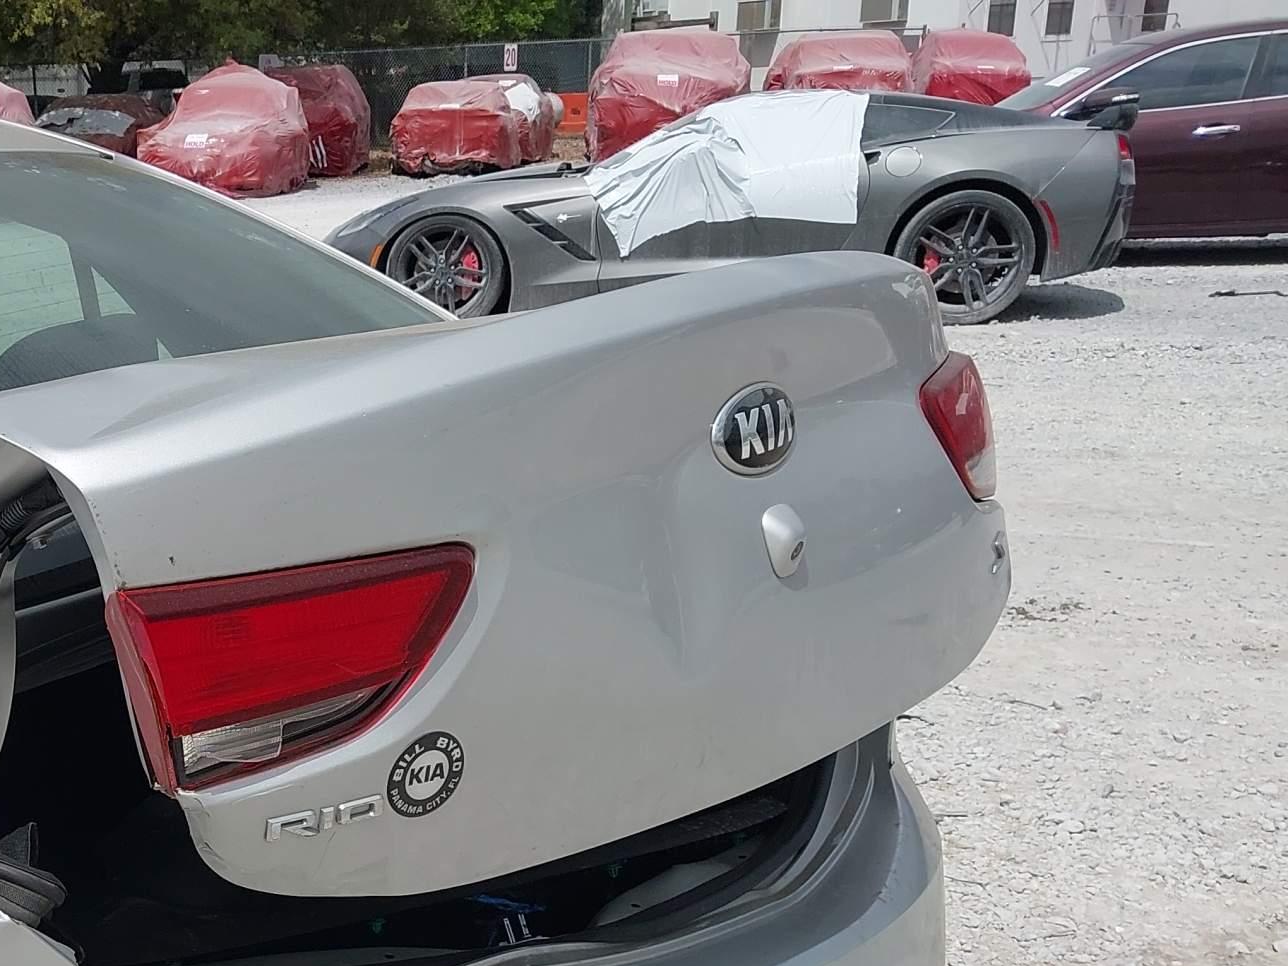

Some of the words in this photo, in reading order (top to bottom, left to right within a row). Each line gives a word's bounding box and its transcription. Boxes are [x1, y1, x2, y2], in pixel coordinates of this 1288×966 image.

[505, 47, 516, 67] 20
[734, 399, 795, 460] KIA
[392, 743, 425, 782] BILL
[435, 736, 462, 772] BYRD
[408, 762, 445, 787] KIA
[390, 788, 423, 814] PANAMA
[448, 776, 459, 789] FL
[265, 793, 385, 842] RIO
